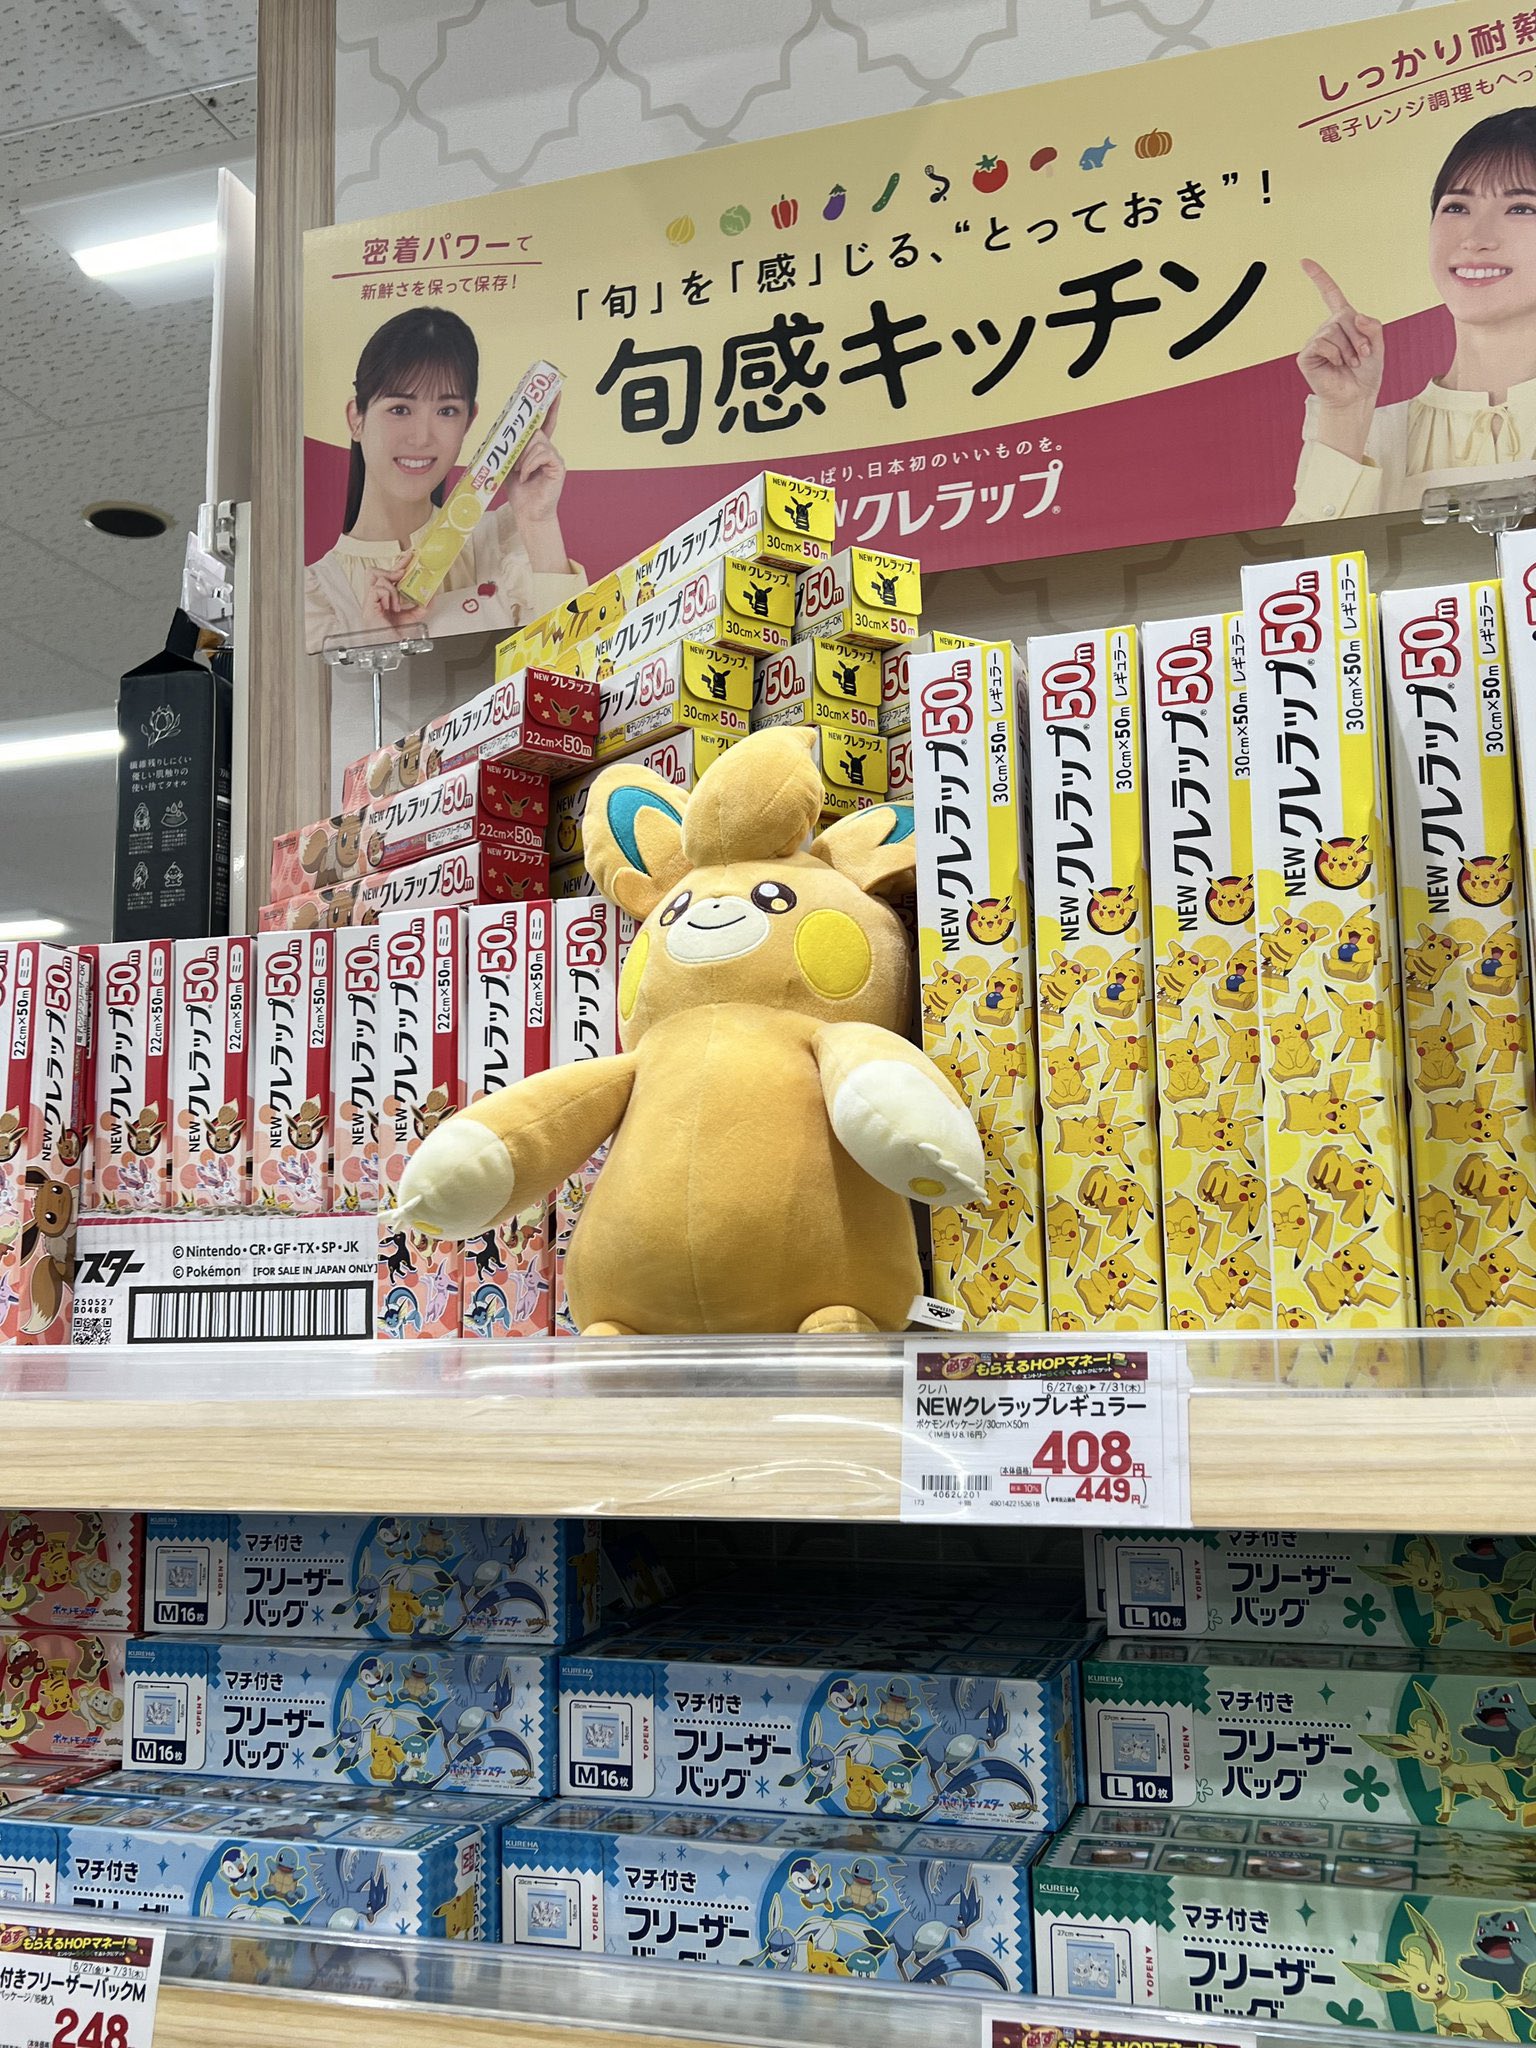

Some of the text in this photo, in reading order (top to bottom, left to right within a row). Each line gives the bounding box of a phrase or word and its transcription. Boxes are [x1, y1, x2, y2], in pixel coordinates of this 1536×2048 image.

[595, 258, 1268, 446] 旬感キッチン
[655, 508, 723, 582] クレラップ
[615, 590, 684, 659] クレラップ
[725, 620, 788, 648] 30cm×50m
[1259, 570, 1321, 657] 50m
[1344, 563, 1365, 731] 30cm×50m レギュラー
[1399, 597, 1462, 680] 50m
[1041, 642, 1096, 721] 50m
[1156, 625, 1213, 707] 50m
[1481, 590, 1506, 753] 30cm×50m レギュラー
[683, 705, 746, 730] 30cm×50m
[921, 659, 973, 738] 50m
[1114, 636, 1132, 790] 30cm×50m レギュラー
[1233, 620, 1251, 777] 30cm×50m レギュラー
[526, 731, 592, 757] 22cm×50m
[990, 652, 1009, 803] 30cm×50m レギュラー
[479, 823, 542, 847] 22cm×50m
[1285, 847, 1306, 897] NEW
[1428, 864, 1450, 914] NEW
[942, 907, 959, 953] NEW
[1060, 895, 1080, 942] NEW
[1178, 884, 1197, 932] NEW
[477, 910, 517, 973] 50m
[566, 903, 607, 967] 50m
[438, 923, 451, 1030] 22cm×50m ミニ
[530, 917, 544, 1025] 22cm×50m ミニ
[14, 957, 30, 1056] 22cm×50m ミニ
[150, 953, 163, 1053] 22cm×50m ミニ
[229, 951, 243, 1050] 22cm×50m ミニ
[312, 944, 326, 1046] 22cm×50m ミニ
[183, 946, 220, 1117] クレラップ 50m
[387, 917, 425, 1142] NEW クレラップ 50m
[45, 1008, 66, 1126] クレラップ
[108, 1007, 133, 1154] NEW クレラップ
[268, 998, 295, 1148] NEW クレラップ
[348, 993, 376, 1145] NEW クレラップ
[253, 1267, 275, 1277] [FOR
[278, 1266, 300, 1276] SALE
[303, 1266, 313, 1275] IN
[315, 1265, 346, 1275] JAPAN
[917, 1383, 948, 1395] クレハ
[917, 1395, 1147, 1418] NEWクレラップレギュラー
[245, 1533, 304, 1552] マチ付き
[1227, 1531, 1298, 1548] マチ付き
[243, 1567, 344, 1597] フリーザー
[1226, 1562, 1352, 1595] フリーザー
[243, 1599, 309, 1628] バッグ
[1230, 1598, 1310, 1628] バッグ
[224, 1671, 284, 1691] マチ付き
[674, 1691, 742, 1716] マチ付き
[1217, 1689, 1295, 1714] マチ付き
[223, 1705, 325, 1738] フリーザー
[223, 1739, 289, 1771] バッグ
[674, 1728, 792, 1765] フリーザー
[1218, 1728, 1353, 1766] フリーザー
[674, 1764, 752, 1798] バッグ
[1221, 1766, 1308, 1801] バッグ
[75, 1858, 139, 1883] マチ付き
[624, 1866, 697, 1893] マチ付き
[624, 1907, 750, 1950] フリーザー
[1183, 1904, 1271, 1935] マチ付き
[1145, 1956, 1155, 1987] OPEN
[1183, 1949, 1337, 1994] フリーザー
[52, 2007, 129, 2048] 248
